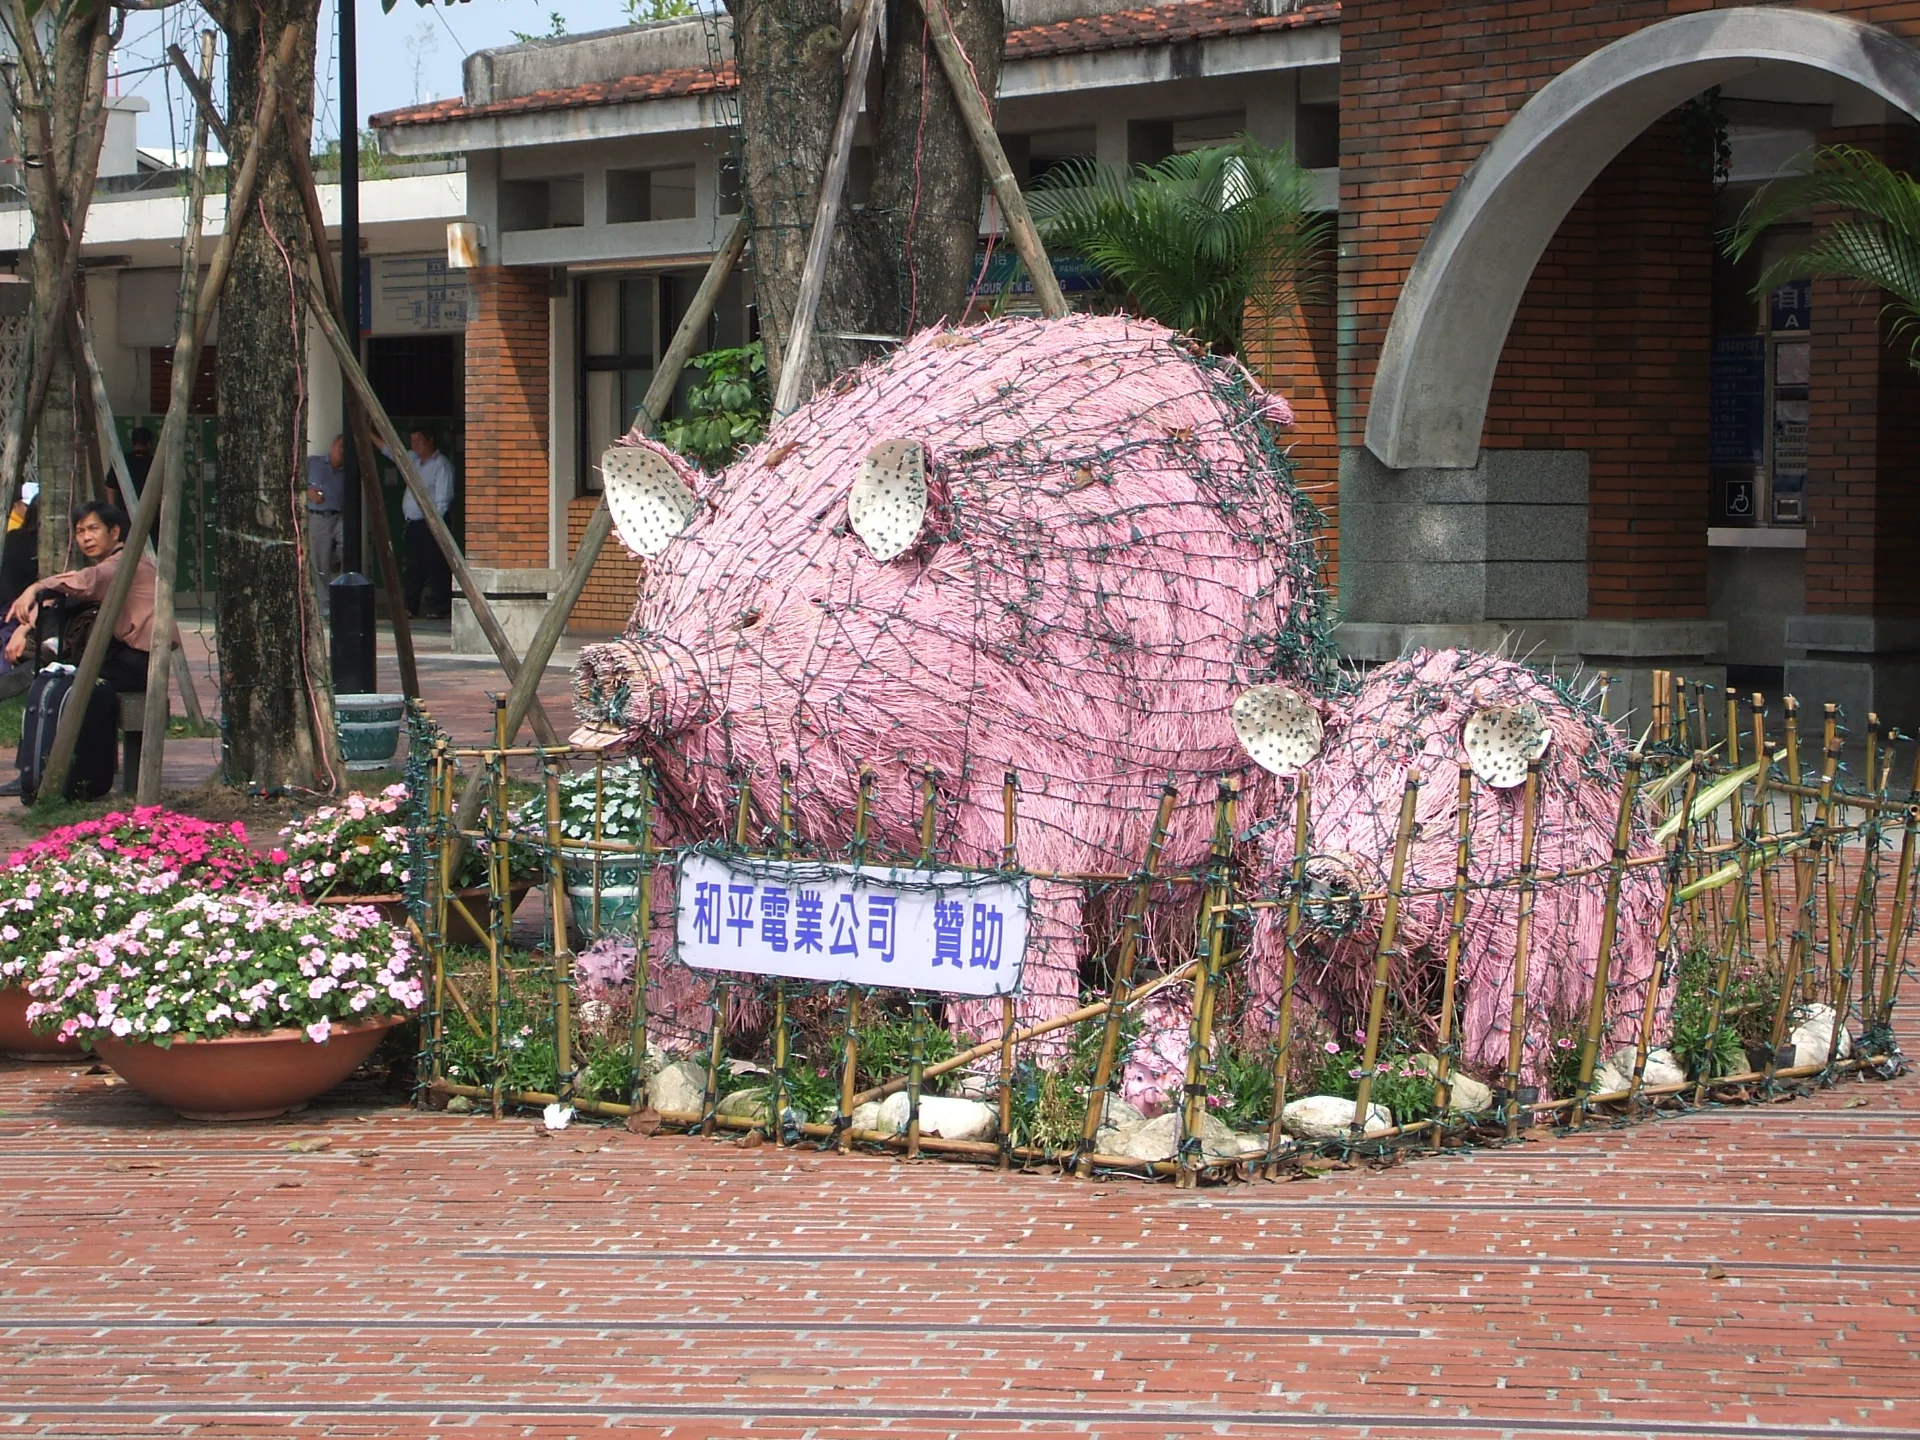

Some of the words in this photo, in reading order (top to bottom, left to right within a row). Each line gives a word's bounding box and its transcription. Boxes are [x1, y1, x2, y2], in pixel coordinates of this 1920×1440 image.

[1006, 281, 1023, 293] TM
[693, 880, 897, 963] 和平電業公司
[931, 900, 1003, 970] 贊助
